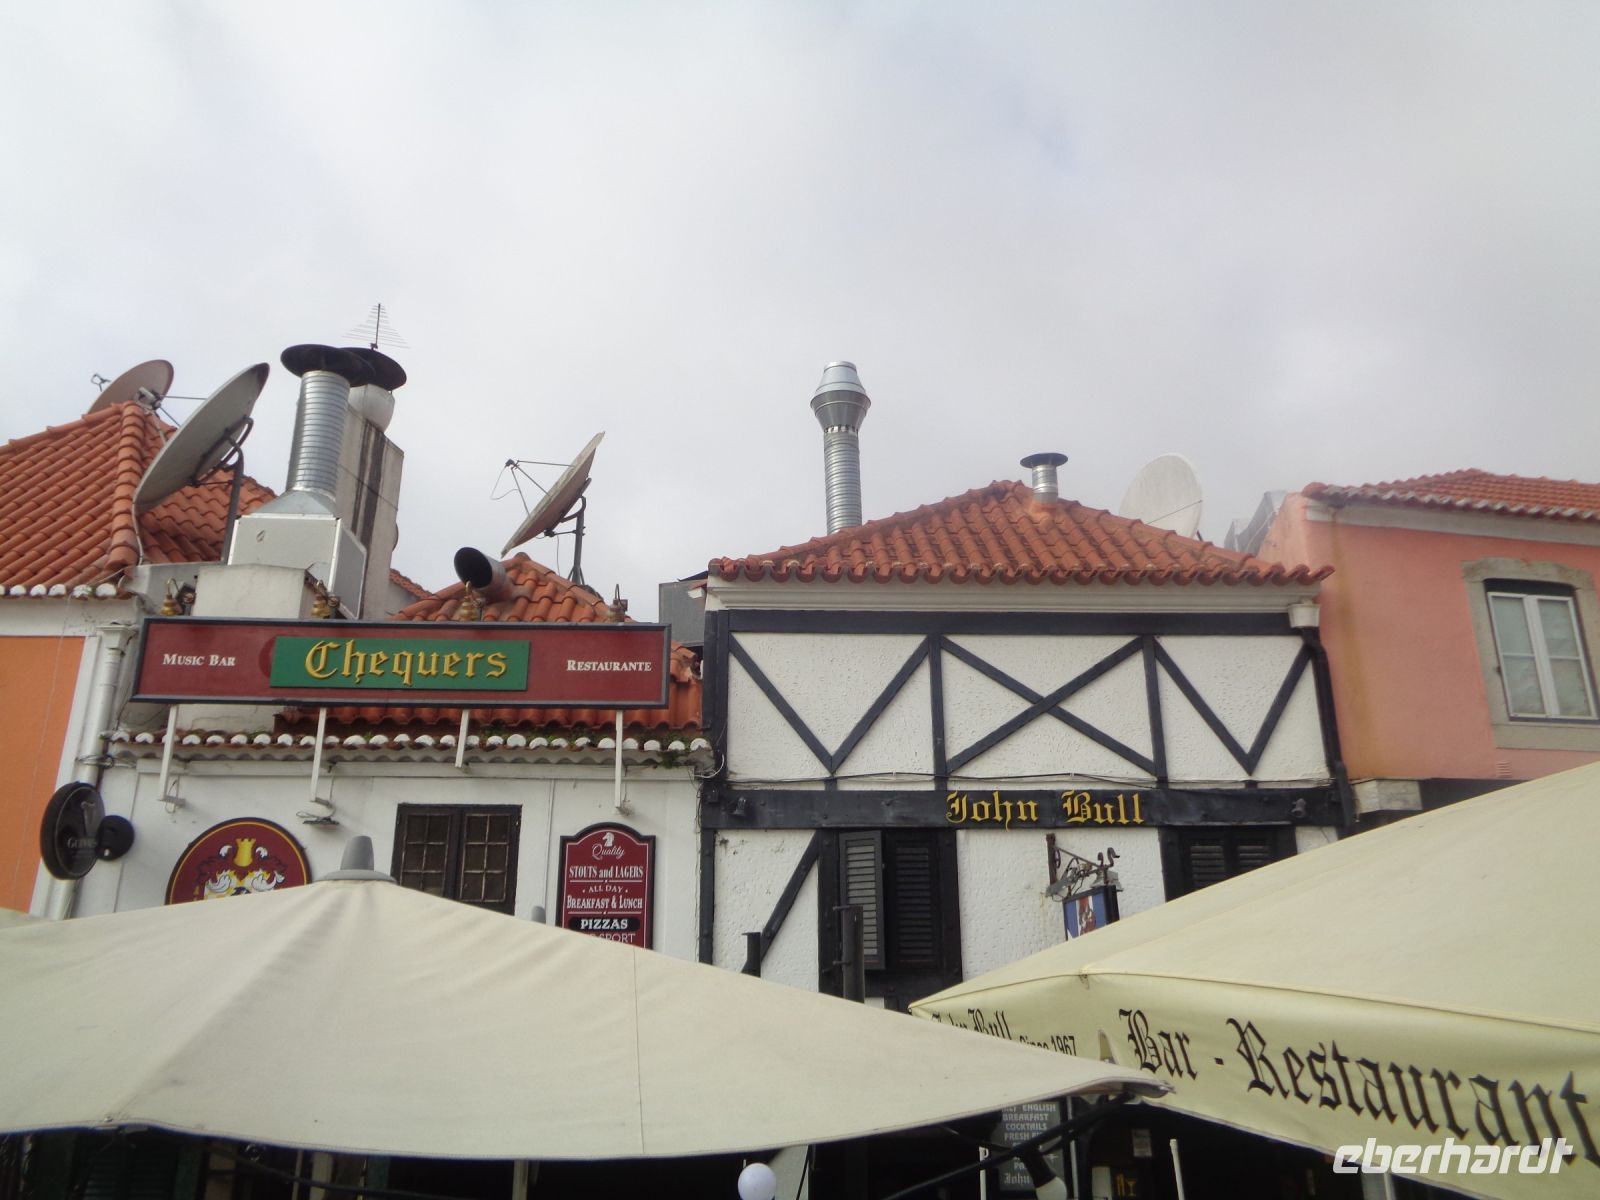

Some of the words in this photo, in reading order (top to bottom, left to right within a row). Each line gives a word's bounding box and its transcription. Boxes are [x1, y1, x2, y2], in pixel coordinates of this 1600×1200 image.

[163, 653, 205, 666] MUSIC
[209, 654, 236, 667] BAR
[305, 639, 508, 686] Chequers
[566, 659, 652, 672] RESTAURANTE
[946, 790, 1039, 832] John
[1061, 789, 1144, 825] Bull
[592, 844, 625, 860] Quality
[569, 865, 598, 878] STOUTS
[599, 866, 613, 878] and
[615, 865, 644, 878] LAGERS
[588, 885, 604, 893] ALL
[605, 885, 623, 893] DAY
[567, 894, 610, 909] BREAKFAST
[611, 895, 617, 909] &
[619, 894, 643, 909] LUNCH
[580, 918, 628, 930] PIZZAS
[1050, 1034, 1076, 1056] 1967
[1118, 1008, 1197, 1081] Bar
[1225, 1017, 1600, 1169] Restaurant
[1002, 1113, 1049, 1121] BREAKFAST
[1005, 1122, 1048, 1131] COCKTAILS
